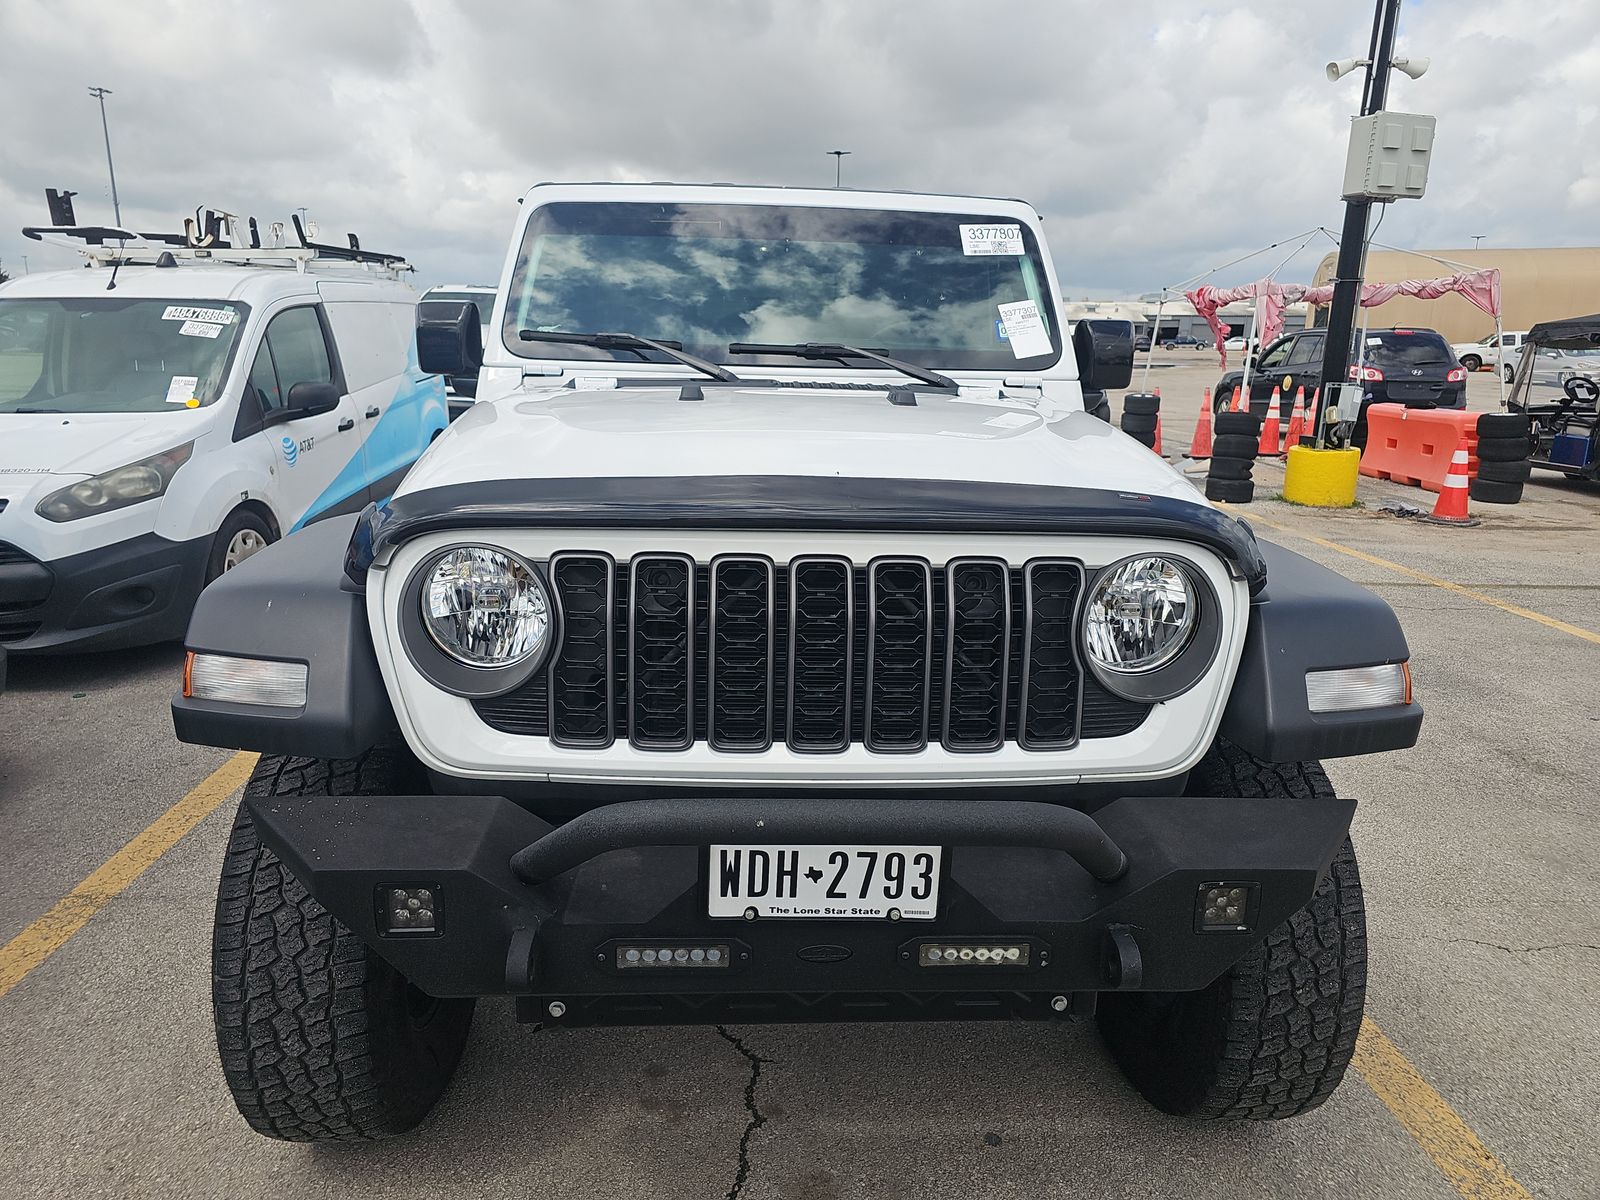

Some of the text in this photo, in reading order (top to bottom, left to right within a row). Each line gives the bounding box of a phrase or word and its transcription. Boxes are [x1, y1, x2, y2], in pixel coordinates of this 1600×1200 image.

[299, 436, 315, 455] AT&T
[720, 849, 935, 900] WDH 2793
[769, 906, 881, 915] The Lone Star State
